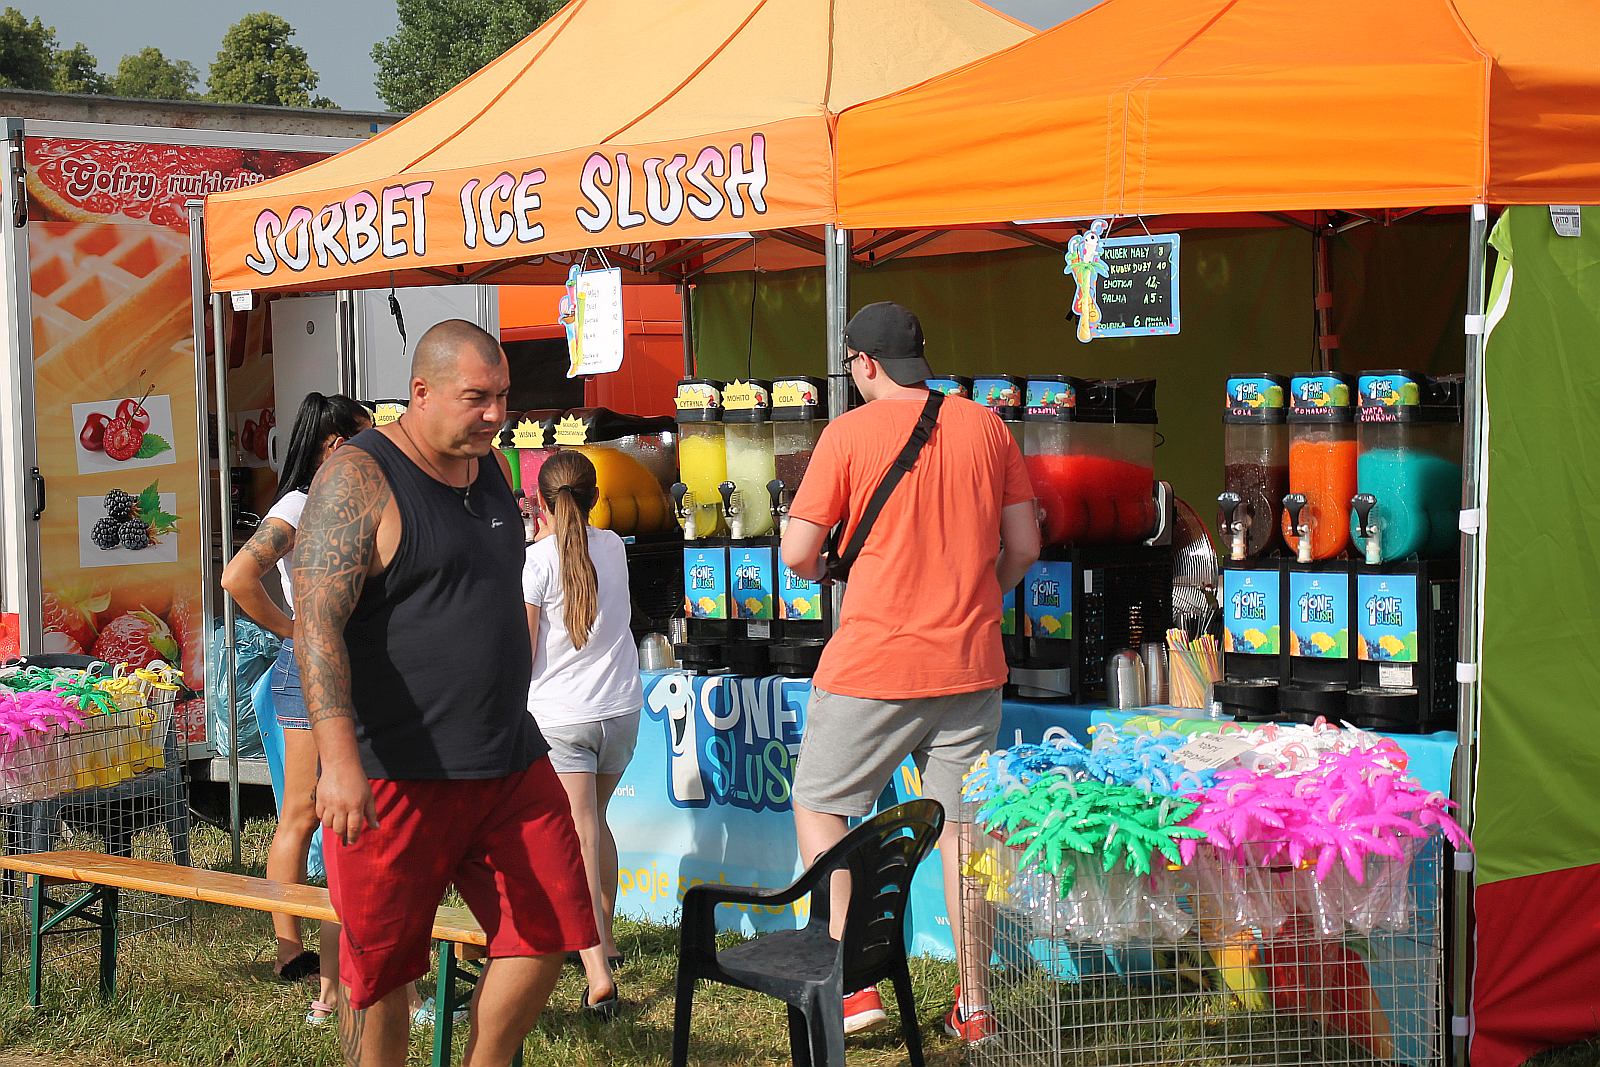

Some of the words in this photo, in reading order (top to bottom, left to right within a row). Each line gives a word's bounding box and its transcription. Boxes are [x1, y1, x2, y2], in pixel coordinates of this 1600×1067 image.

[61, 158, 155, 201] Gofry
[246, 180, 434, 275] SORBET
[460, 167, 546, 250] ICE
[576, 133, 768, 233] SLUSH
[1105, 248, 1128, 260] KUBEK
[1110, 264, 1131, 274] KUBEK
[1156, 262, 1166, 271] 10
[1134, 316, 1140, 327] 6
[1039, 581, 1059, 596] ONE
[1242, 592, 1265, 608] ONE
[1309, 595, 1333, 611] ONE
[1376, 597, 1401, 614] ONE
[701, 676, 809, 756] ONE
[618, 860, 669, 903] poje
